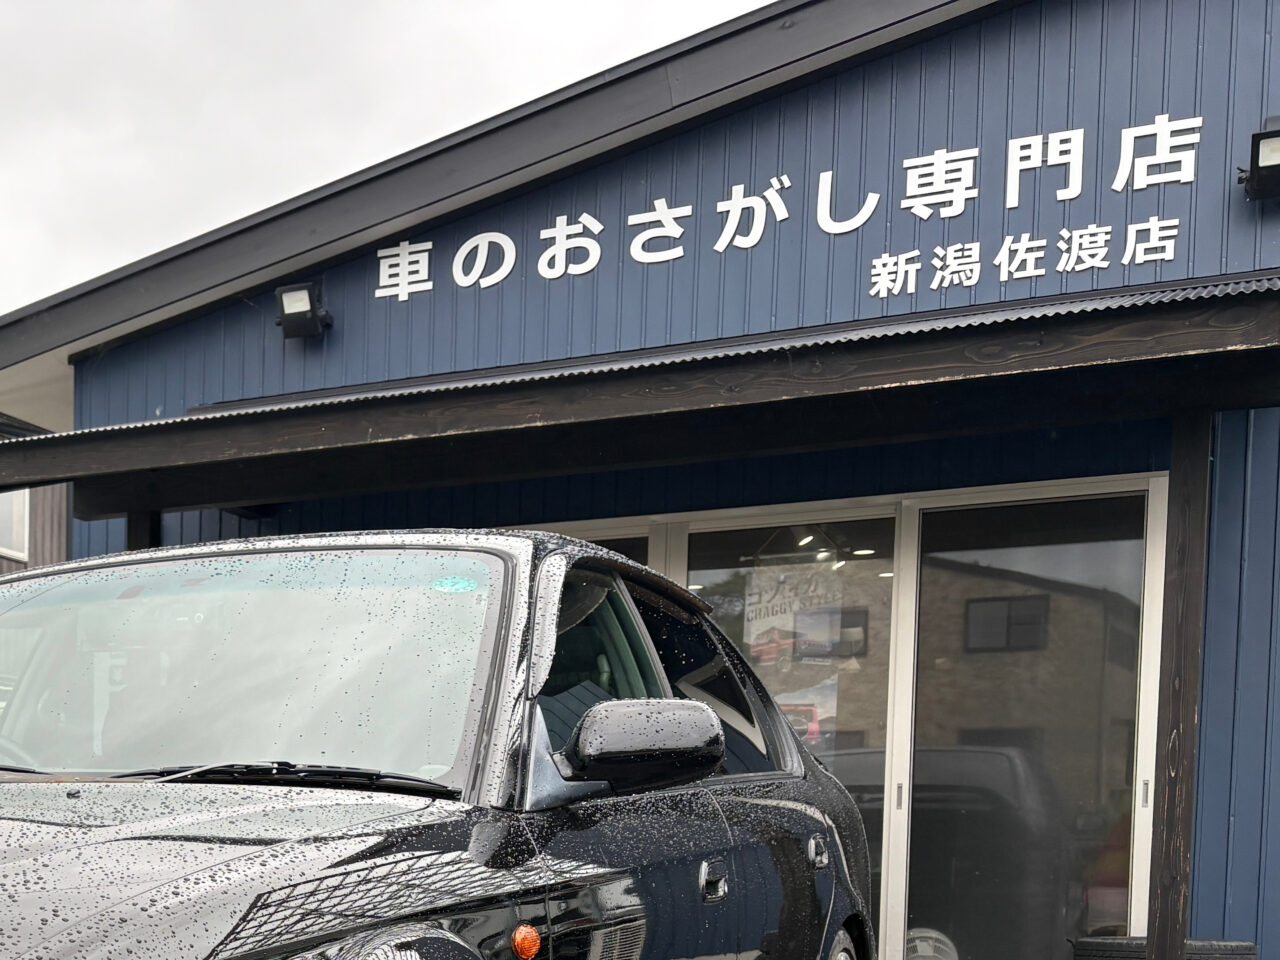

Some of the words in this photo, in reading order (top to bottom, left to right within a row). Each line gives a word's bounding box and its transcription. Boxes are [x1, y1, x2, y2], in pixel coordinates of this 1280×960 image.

[375, 113, 1204, 302] 車のおさがし専門店
[868, 215, 1181, 299] 新潟佐渡店
